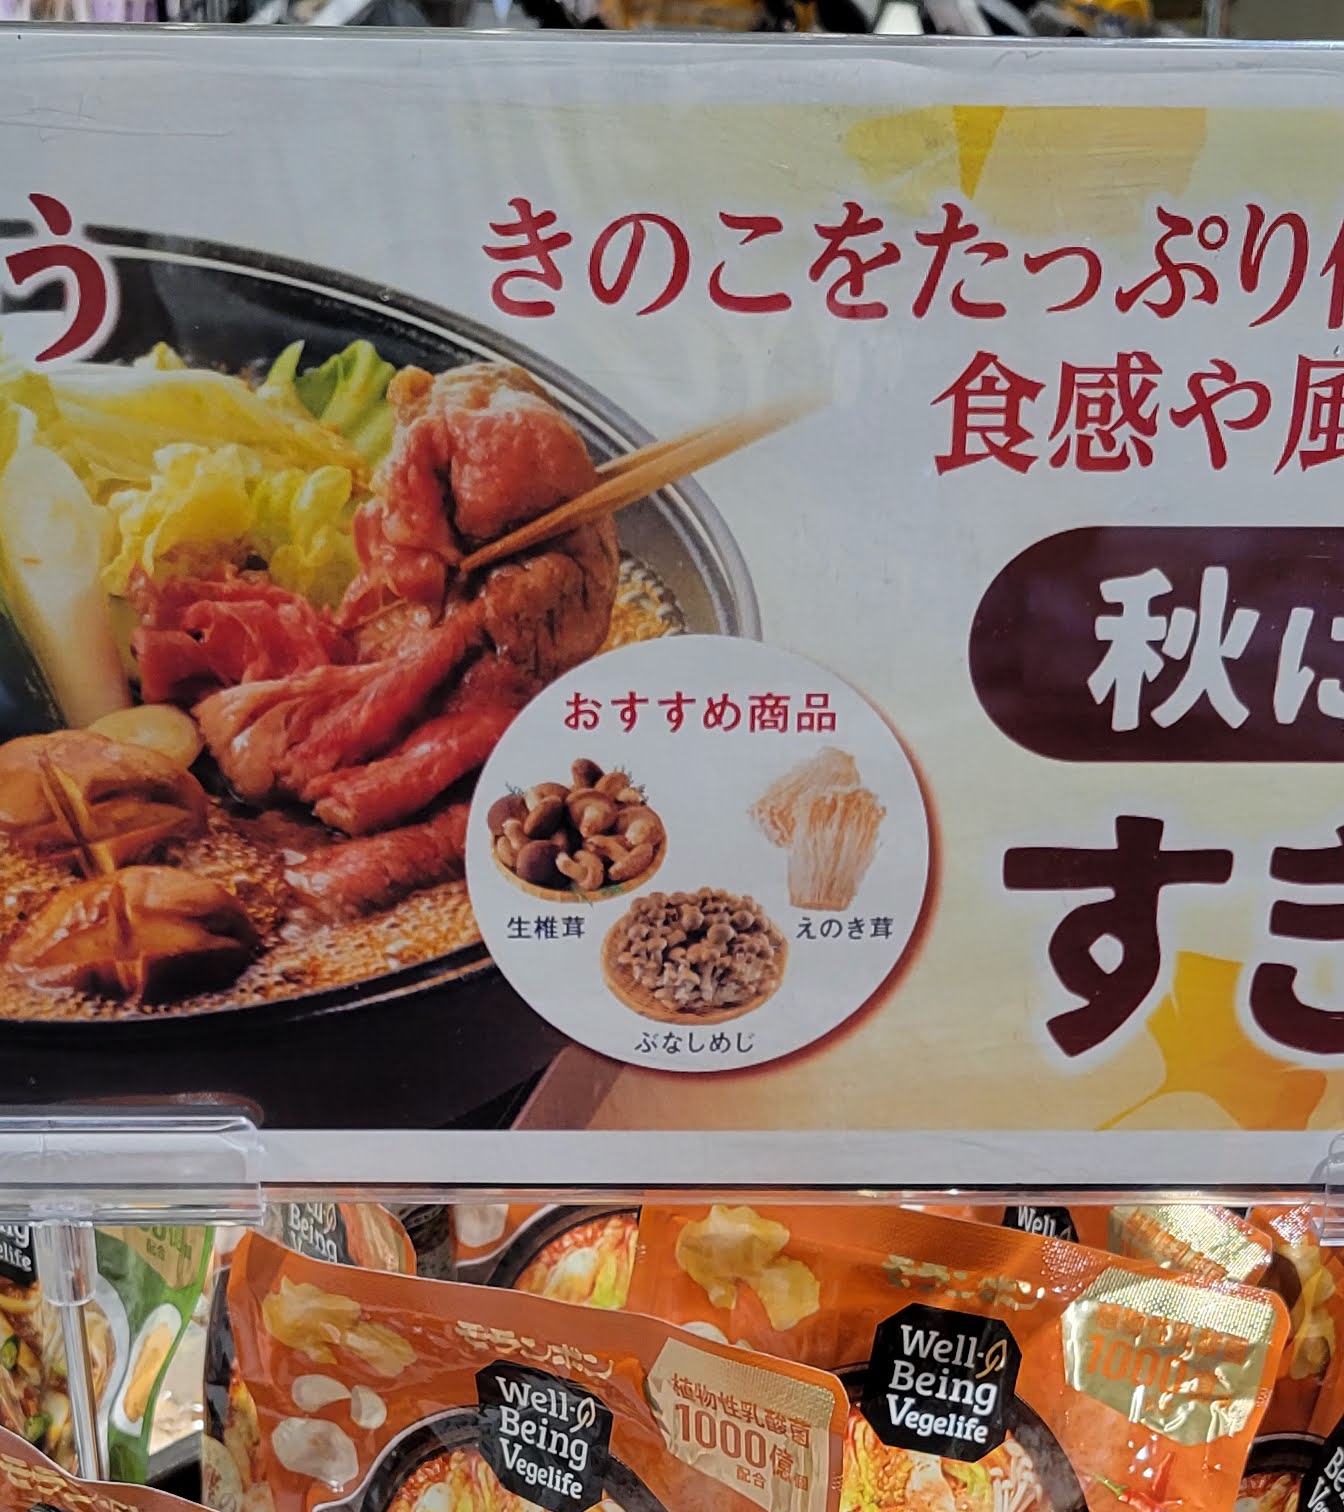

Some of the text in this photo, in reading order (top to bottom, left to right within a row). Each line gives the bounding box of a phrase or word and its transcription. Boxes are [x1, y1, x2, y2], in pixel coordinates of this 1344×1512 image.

[564, 692, 838, 733] おすすめ商品
[507, 916, 586, 940] 生椎茸
[796, 916, 894, 940] えのき茸
[634, 1032, 755, 1055] ぶなしめじ
[455, 1320, 616, 1380] モランボン
[900, 1325, 984, 1371] Well-
[496, 1376, 577, 1422] Well-
[671, 1371, 811, 1449] 植物性乳酸菌
[890, 1361, 998, 1414] Being
[500, 1408, 589, 1471] Being
[886, 1396, 989, 1446] Vegelife
[500, 1440, 584, 1500] Vegelife
[736, 1466, 767, 1490] 配合
